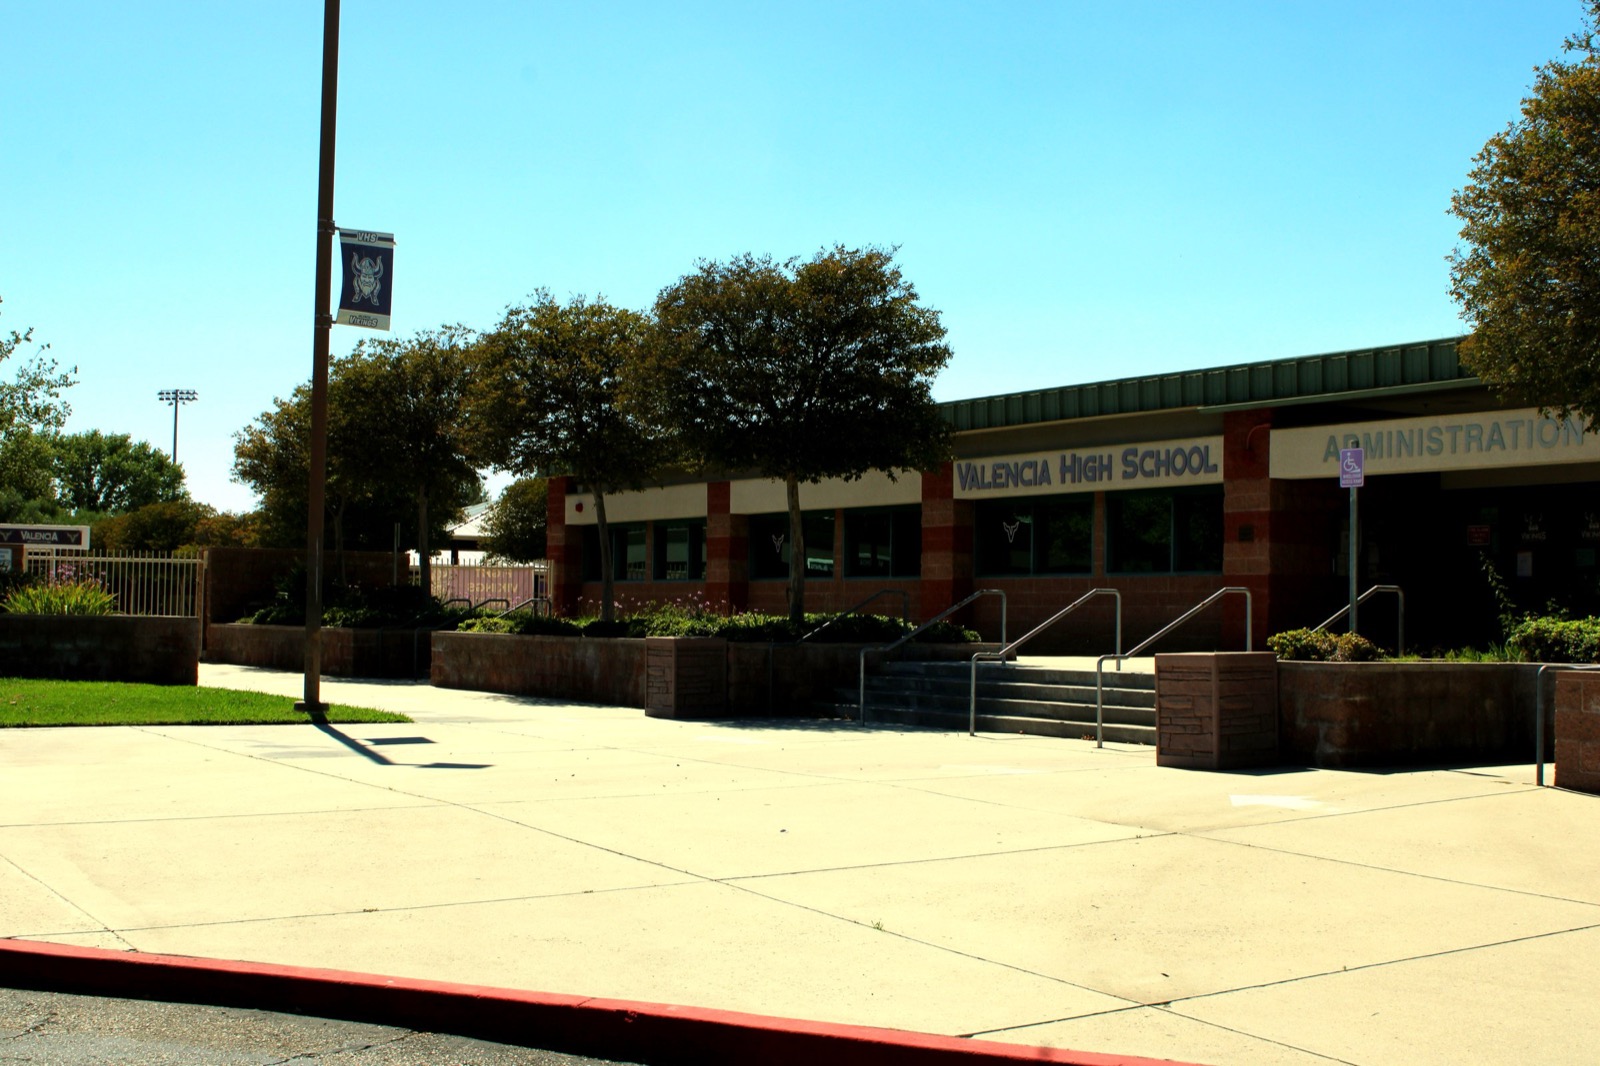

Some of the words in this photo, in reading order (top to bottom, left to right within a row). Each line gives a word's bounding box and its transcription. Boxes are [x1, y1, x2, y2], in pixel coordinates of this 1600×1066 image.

[357, 232, 377, 243] VHS
[957, 460, 1051, 491] VALENCIA
[1060, 453, 1113, 484] HIGH
[1121, 445, 1218, 480] SCHOOL
[20, 530, 58, 541] VALENCIA
